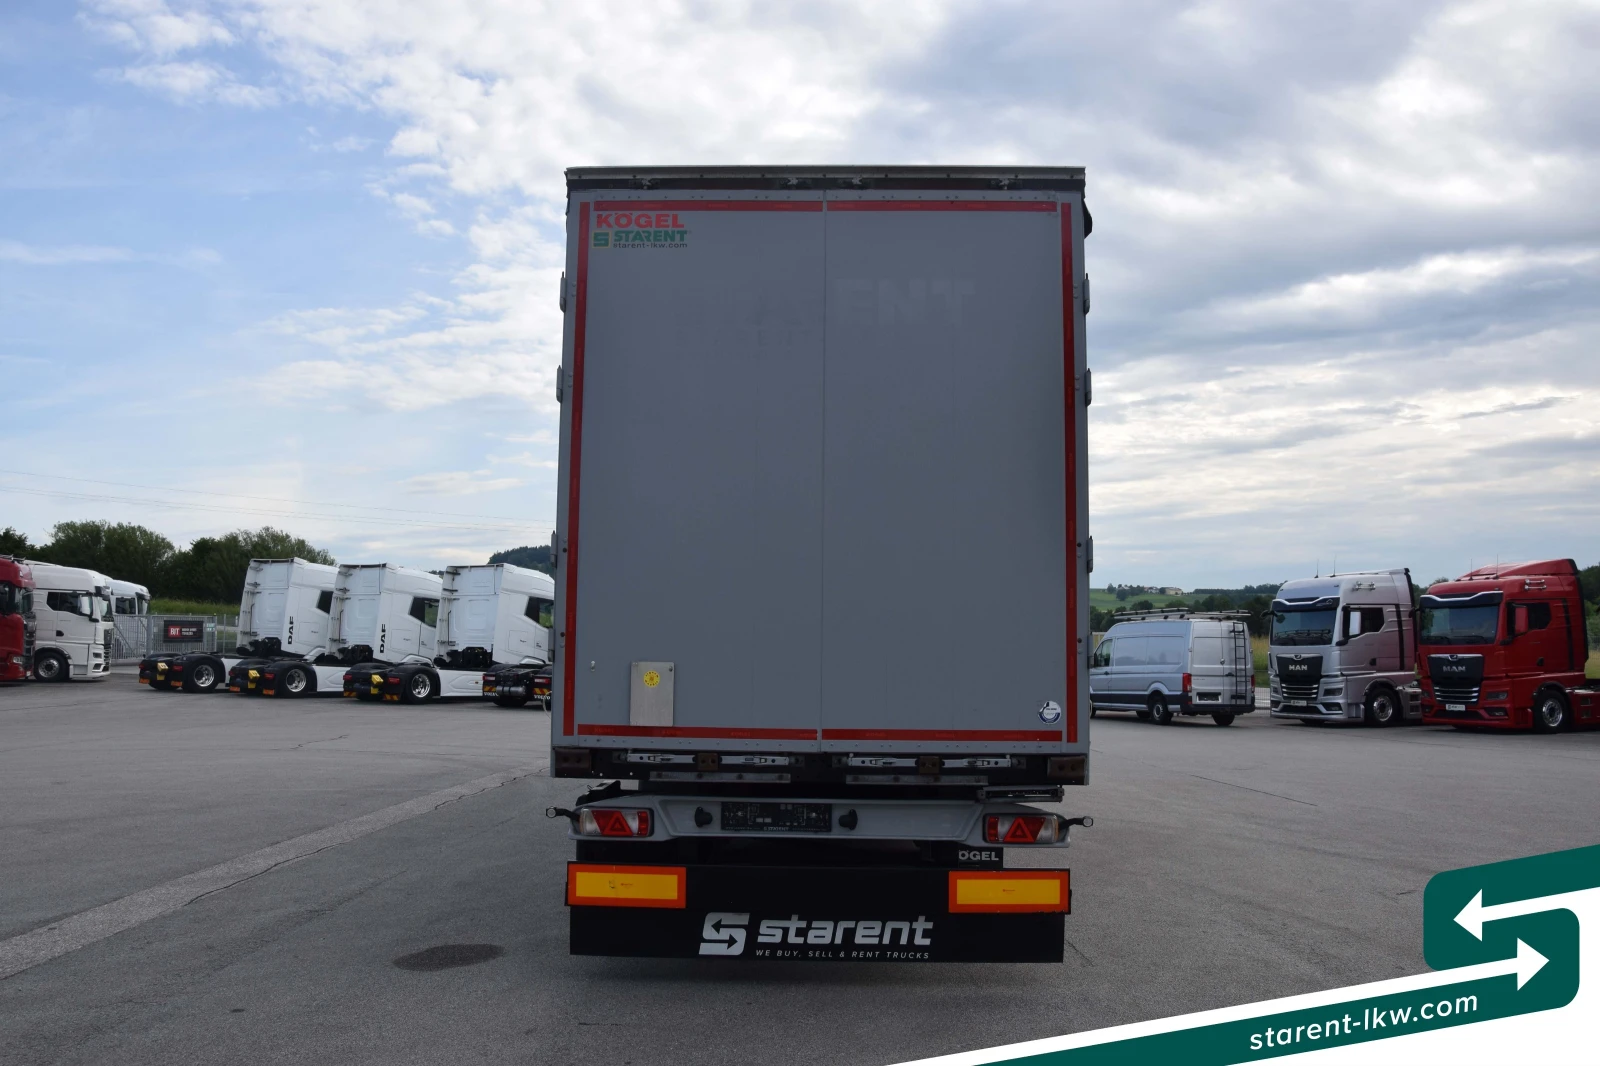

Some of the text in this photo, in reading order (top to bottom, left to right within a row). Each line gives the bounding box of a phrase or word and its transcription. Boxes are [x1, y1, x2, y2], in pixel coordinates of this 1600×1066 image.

[596, 212, 685, 229] KÖGEL
[614, 230, 688, 242] STARENT
[958, 849, 999, 861] ÖGEL
[757, 914, 934, 946] starent
[756, 949, 771, 957] WE
[777, 950, 801, 958] BUY,
[808, 950, 833, 958] SELL
[852, 951, 880, 959] RENT
[886, 951, 930, 959] TRUCKS
